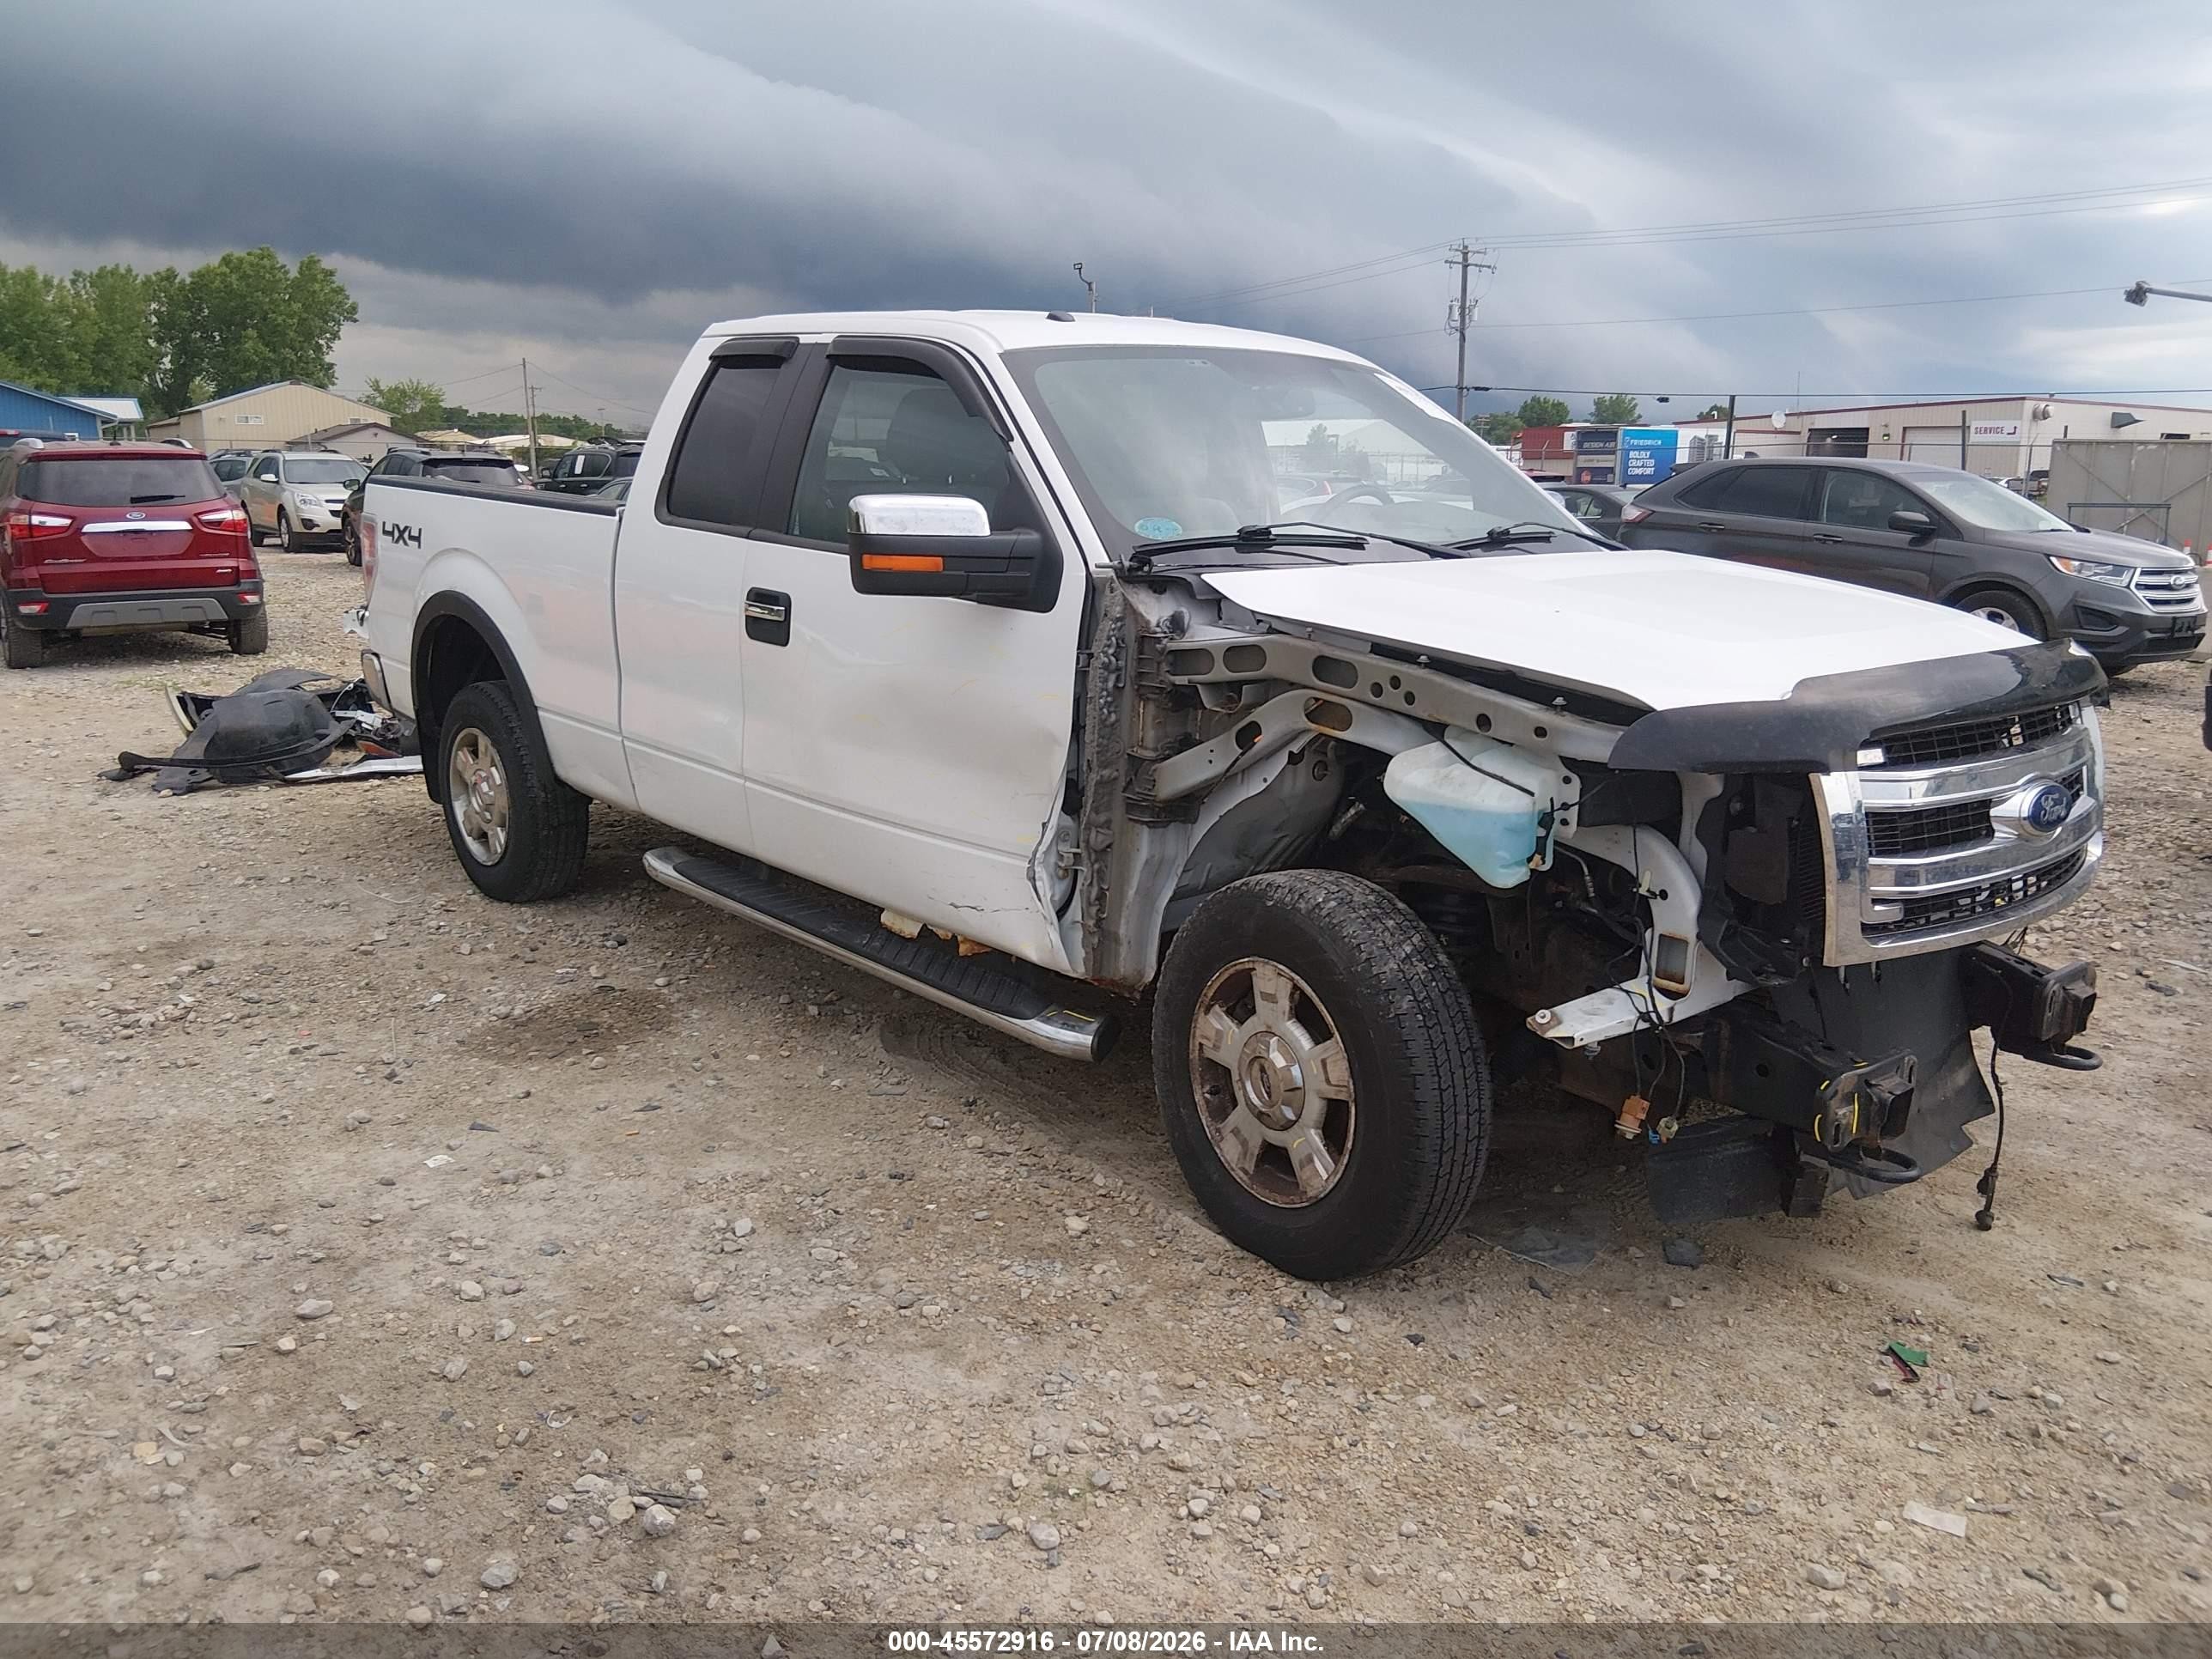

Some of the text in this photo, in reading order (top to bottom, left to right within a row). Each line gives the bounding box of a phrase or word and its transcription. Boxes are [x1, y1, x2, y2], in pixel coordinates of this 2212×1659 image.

[1974, 426, 2005, 434] SERVICE
[1628, 459, 1655, 467] CRAFTED
[2040, 793, 2068, 825] Ford
